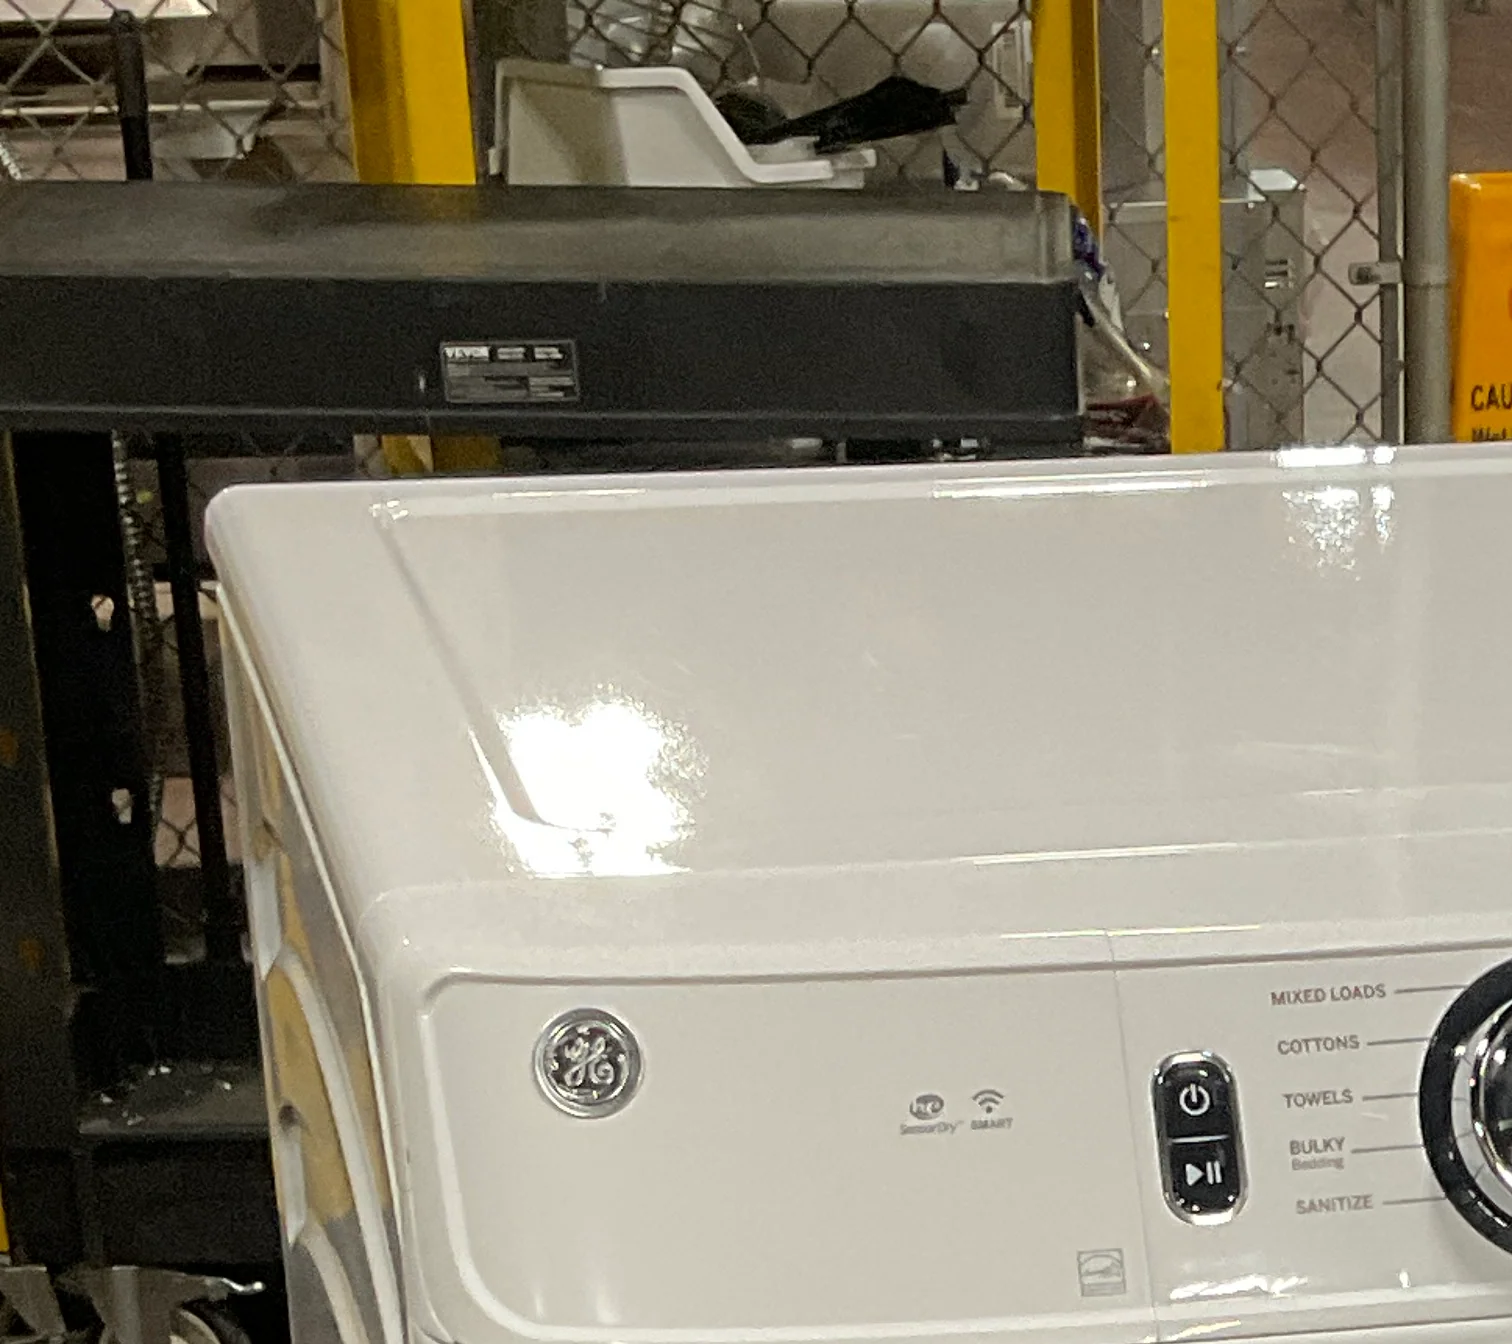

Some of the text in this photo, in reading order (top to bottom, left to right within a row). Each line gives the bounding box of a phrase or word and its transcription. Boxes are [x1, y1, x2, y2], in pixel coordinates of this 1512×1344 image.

[1271, 984, 1386, 1005] MIXED LOADS
[1277, 1035, 1360, 1055] COTTONS
[1283, 1089, 1353, 1108] TOWELS
[970, 1117, 1013, 1130] SMART
[1290, 1137, 1345, 1155] BULKY
[1296, 1194, 1374, 1215] SANITIZE
